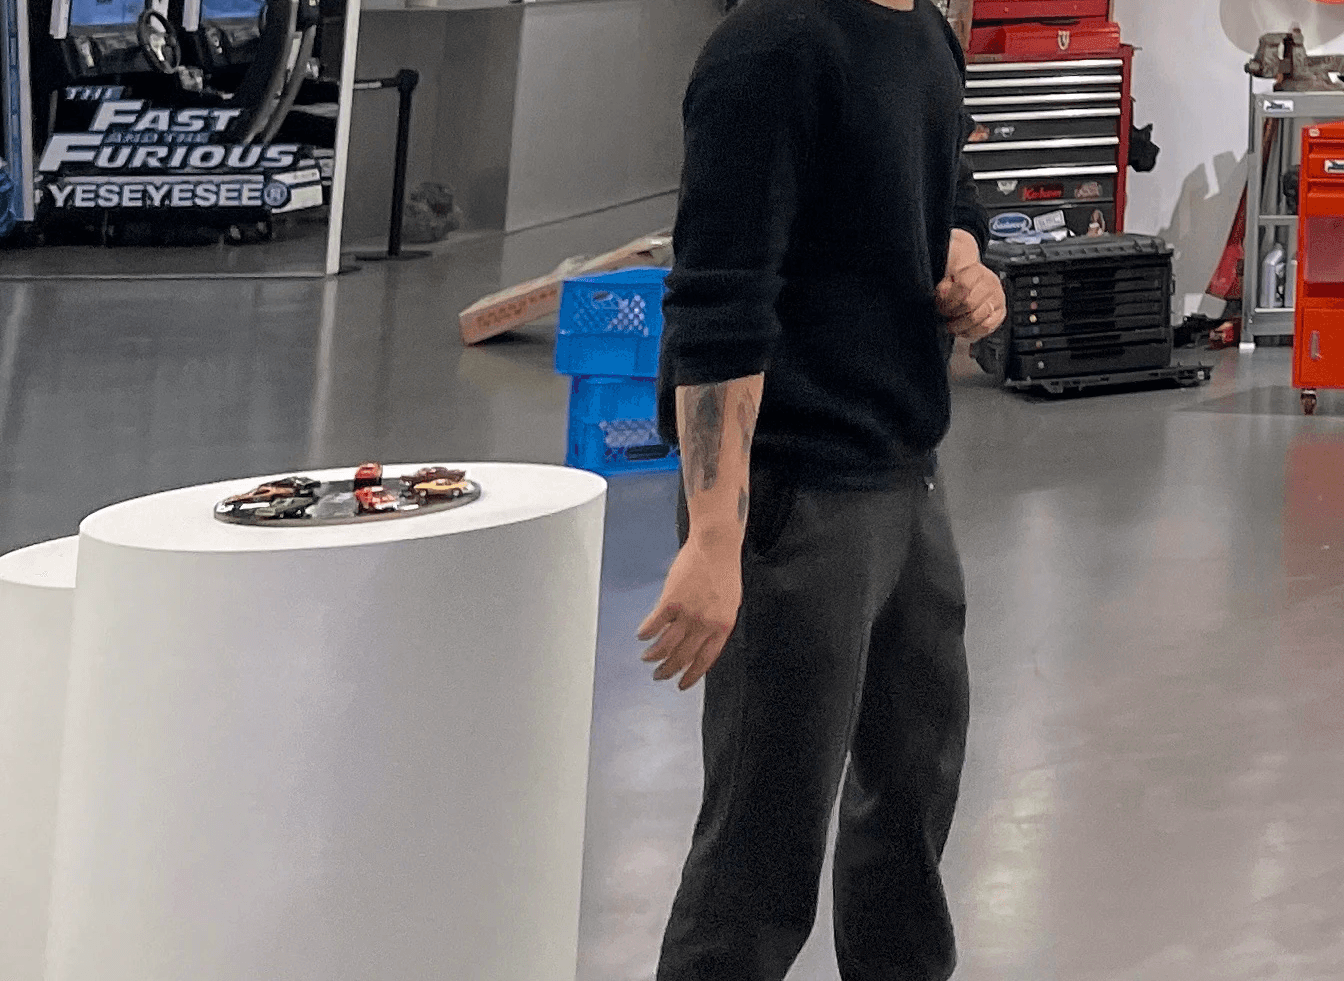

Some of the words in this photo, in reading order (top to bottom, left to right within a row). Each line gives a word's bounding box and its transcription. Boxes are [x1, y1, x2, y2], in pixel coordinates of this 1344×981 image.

[65, 85, 124, 101] THE
[88, 99, 242, 132] FAST
[38, 133, 299, 172] FURIOUS
